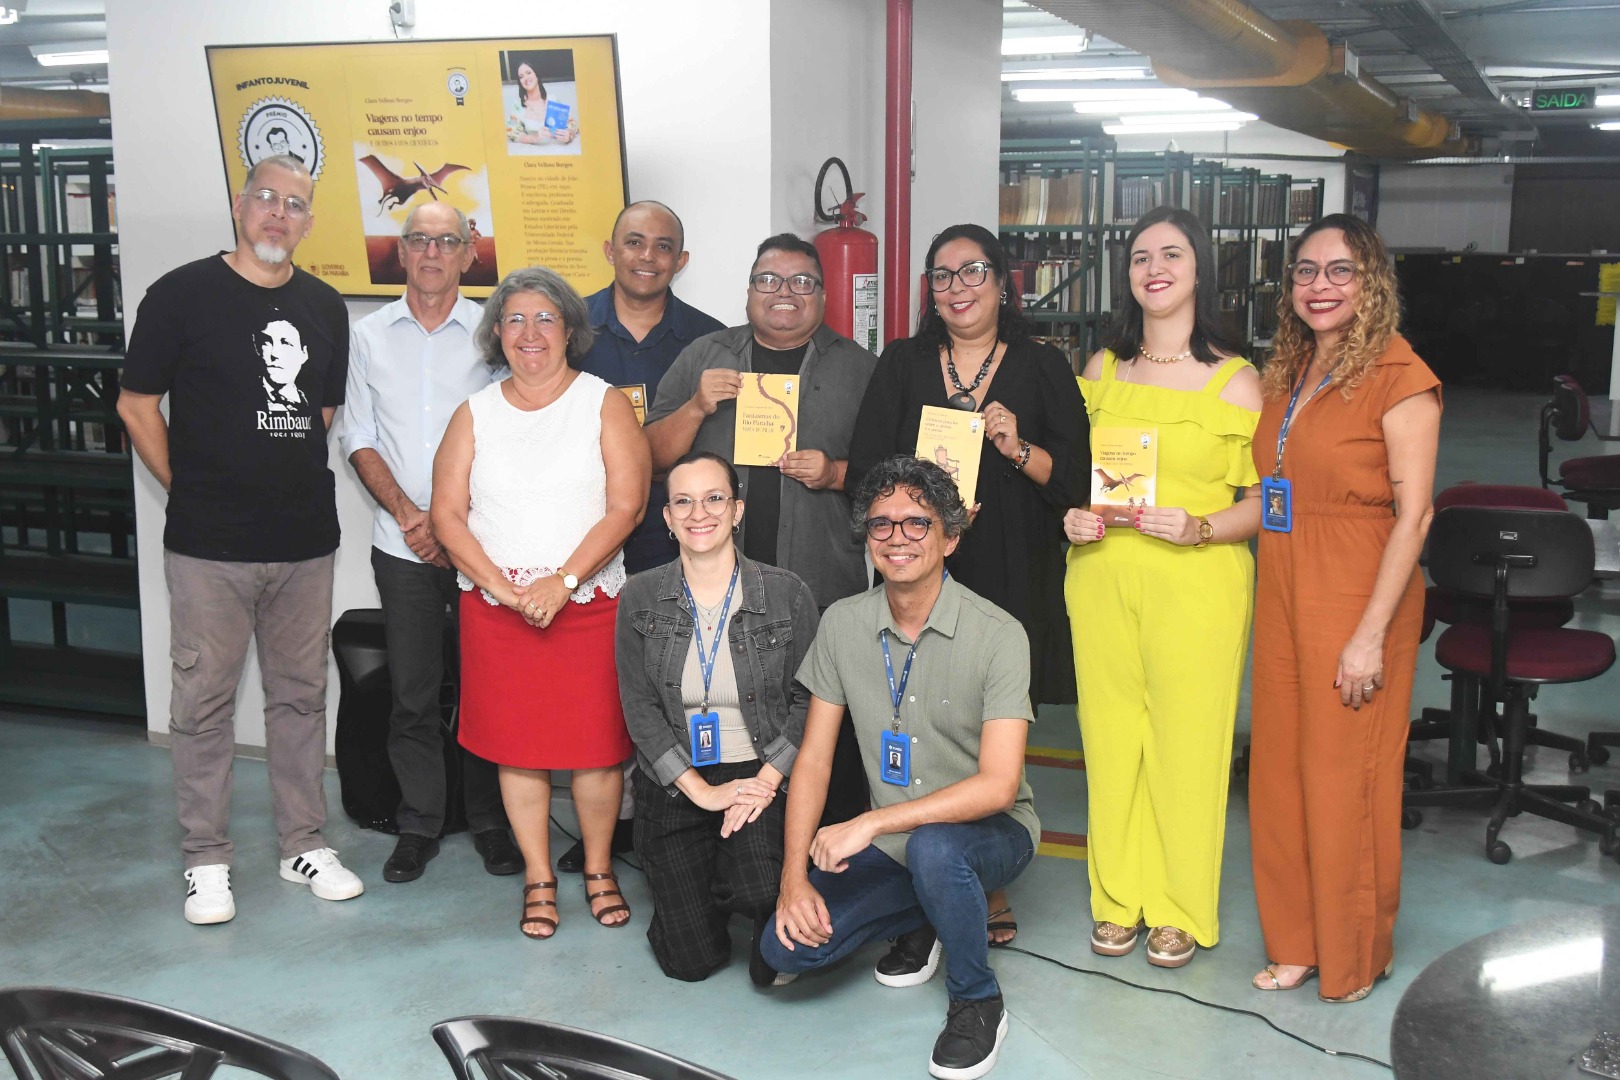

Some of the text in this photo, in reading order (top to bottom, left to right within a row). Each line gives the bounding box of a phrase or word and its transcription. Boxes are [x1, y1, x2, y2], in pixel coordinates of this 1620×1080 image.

[236, 77, 309, 91] INFANTOJUVENIL
[1536, 92, 1588, 108] SAÍDA
[366, 114, 399, 125] Viagens
[415, 114, 442, 124] tempo
[403, 126, 427, 137] enjoo
